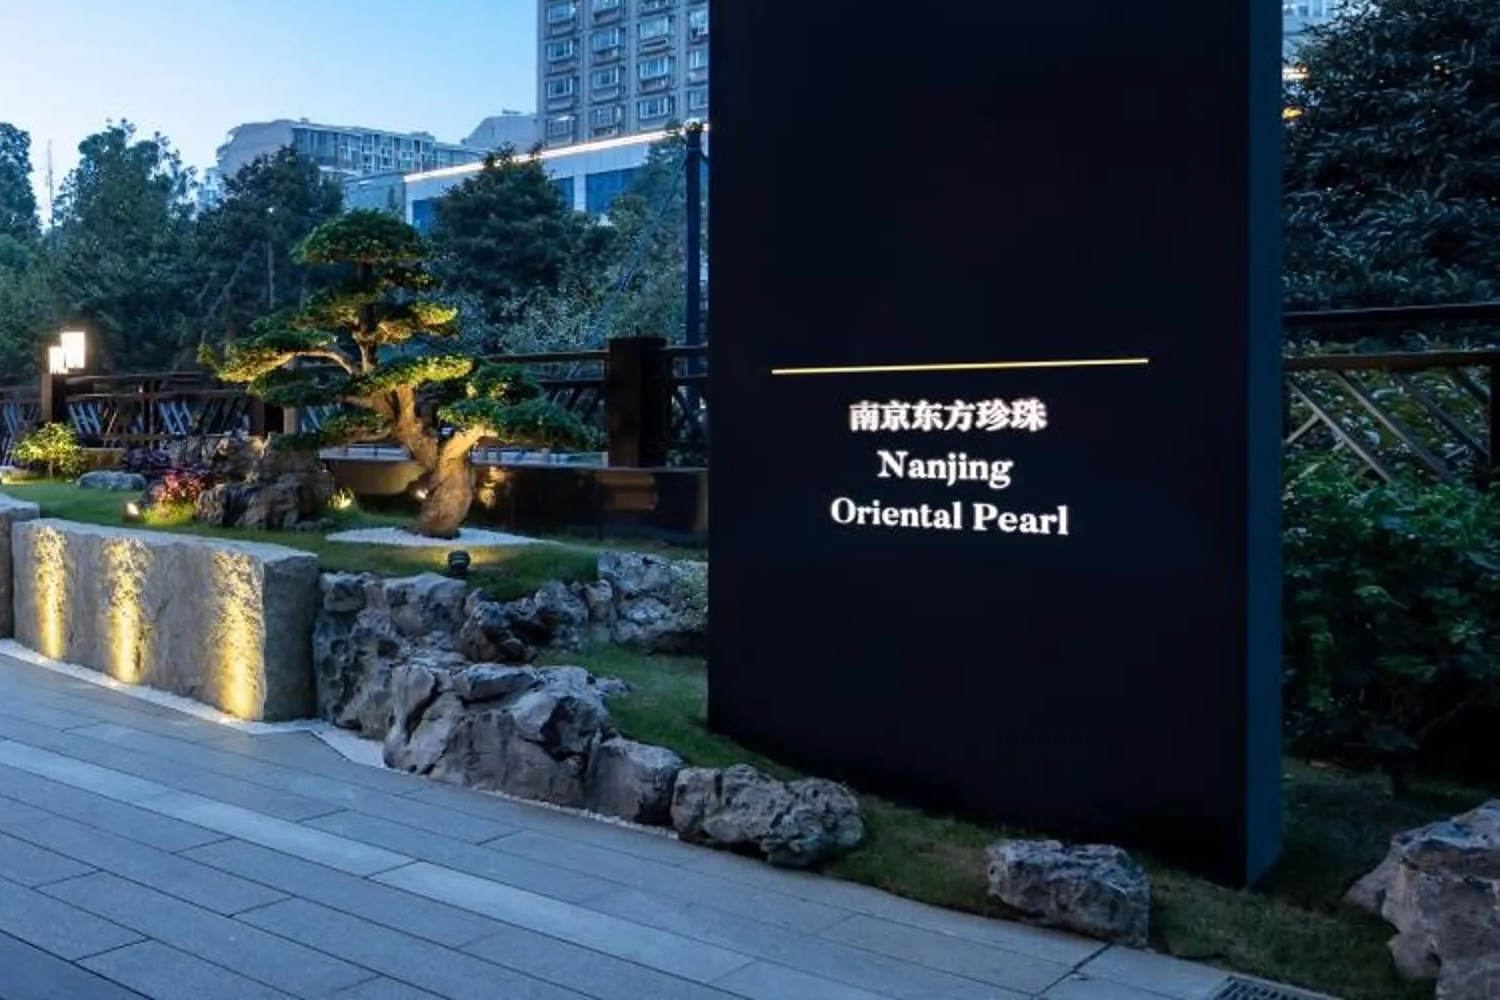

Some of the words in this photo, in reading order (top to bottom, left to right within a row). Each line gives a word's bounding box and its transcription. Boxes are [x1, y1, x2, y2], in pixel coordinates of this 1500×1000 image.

[848, 397, 1048, 432] 南京东方珍珠
[876, 449, 1014, 489] Nanjing
[830, 496, 963, 530] Oriental
[972, 502, 1069, 536] Pearl
